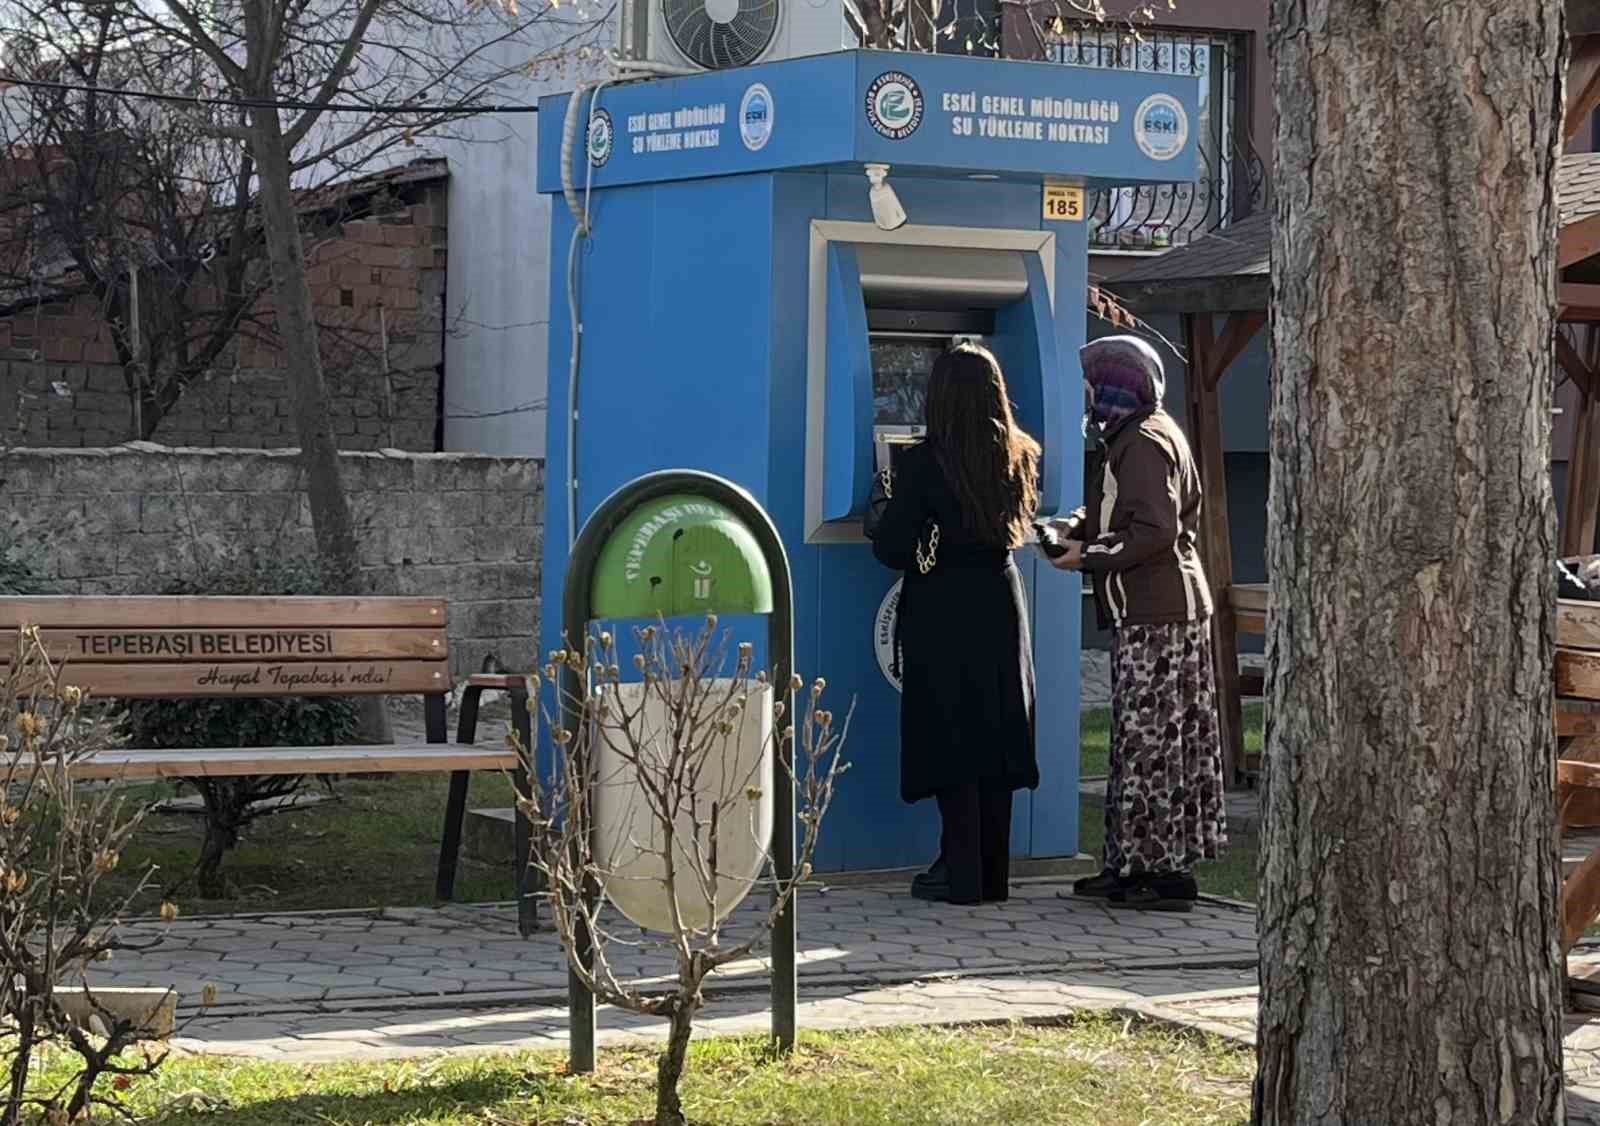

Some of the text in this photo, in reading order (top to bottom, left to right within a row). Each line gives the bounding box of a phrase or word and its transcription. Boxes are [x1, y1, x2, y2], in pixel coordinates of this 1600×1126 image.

[943, 91, 976, 113] ESKİ
[982, 95, 1025, 116] GENEL
[1031, 97, 1120, 123] MÜDÜRLÜĞÜ
[648, 112, 672, 131] GENEL
[952, 116, 1109, 144] SU YÜKLEME NOKTASI
[632, 136, 644, 154] SU
[1047, 199, 1078, 216] 185
[76, 631, 333, 658] TEPEBAŞI BELEDİYESİ
[197, 666, 393, 690] Hayal Tepebaşı'nda!
